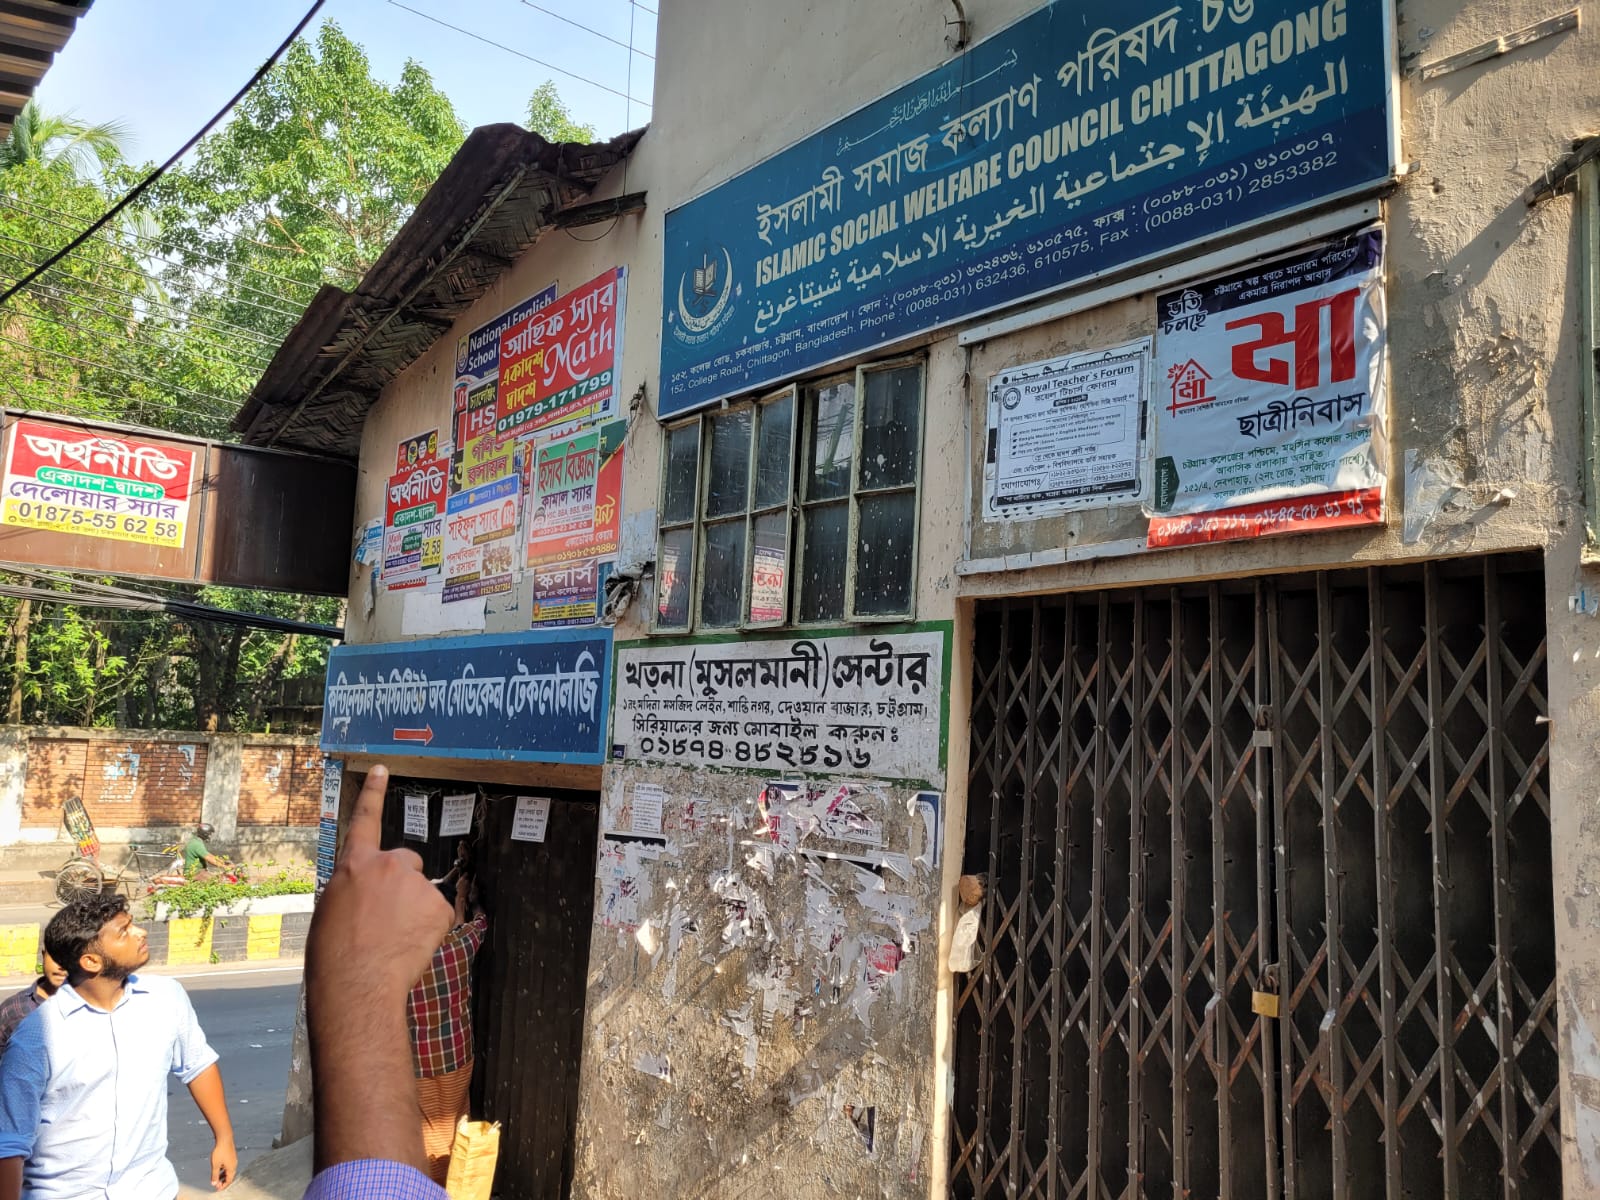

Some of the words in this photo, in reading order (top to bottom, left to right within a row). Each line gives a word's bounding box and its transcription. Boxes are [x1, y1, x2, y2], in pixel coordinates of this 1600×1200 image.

[755, 231, 826, 288] ISLAMIC
[830, 200, 899, 257] SOCIAL
[903, 151, 1002, 226] WELFARE
[1007, 97, 1124, 180] COUNCIL
[1131, 0, 1348, 125] CHITTAGONG
[756, 165, 844, 246] ইসলামী
[852, 133, 931, 197] সমাজ
[939, 72, 1041, 156] কল্যাণ
[1057, 5, 1183, 96] পরিষদ
[954, 182, 1045, 249] الخيرية
[688, 373, 718, 389] College
[720, 364, 745, 378] Road,
[747, 347, 792, 370] Chittagon,
[795, 325, 856, 353] Bangladesh.
[860, 309, 896, 330] Phone
[905, 284, 973, 317] (0088-031)
[976, 263, 1031, 291] 632436,
[1034, 240, 1094, 269] 610575,
[1100, 227, 1129, 247] Fax
[1145, 185, 1243, 233] (0088-031)
[1248, 151, 1338, 195] 2853382
[690, 359, 711, 375] কলেজ
[713, 355, 733, 369] রোড,
[735, 338, 772, 360] চকবাজার,
[775, 327, 804, 346] চট্টগ্রাম,
[858, 299, 881, 316] ফোন
[1093, 207, 1126, 229] ফ্যাক্স
[1143, 162, 1249, 215] (০০৮৮-০৩১)
[1255, 132, 1335, 169] ৬১০৩০৭
[1263, 269, 1284, 285] খরচে
[1286, 259, 1318, 277] মনোরম
[1321, 246, 1360, 266] পরিবেশে
[1239, 286, 1269, 301] একমাত্র
[1271, 277, 1302, 294] নিরাপদ
[1304, 269, 1332, 285] আবাস
[569, 281, 615, 334] স্যার
[1163, 311, 1209, 336] চলছে
[469, 317, 511, 352] National
[543, 318, 613, 387] Math
[1225, 287, 1361, 391] মা
[468, 349, 497, 372] School
[500, 349, 545, 387] একাদশ
[505, 379, 537, 410] দ্বাদশ
[1024, 380, 1051, 396] Royal
[1100, 364, 1134, 380] Forum
[1059, 385, 1083, 399] টিচার্স
[1086, 378, 1117, 394] ফোরাম
[498, 370, 612, 431] 01979-171799
[1236, 392, 1366, 440] ছাত্রীনিবাস
[22, 433, 185, 480] অর্থনীতি
[538, 449, 564, 492] হিসাব
[565, 441, 597, 486] বিজ্ঞান
[1182, 456, 1207, 470] চট্টগ্রাম
[1210, 452, 1244, 468] কলেজের
[1248, 446, 1278, 461] পশ্চিমে,
[1282, 438, 1311, 454] মহসিন
[1313, 433, 1343, 448] কলেজ
[1216, 461, 1252, 476] আবাসিক
[1255, 455, 1288, 470] এলাকায়
[1277, 464, 1297, 479] রোড,
[1300, 457, 1336, 475] মসজিদের
[10, 481, 120, 511] দেলোয়ার
[127, 497, 179, 521] স্যার
[40, 468, 161, 499] একাদশ-দ্বাদশ
[390, 467, 446, 507] অর্থনীতি
[541, 490, 570, 510] কামাল
[572, 484, 594, 505] স্যার
[18, 501, 117, 530] 01875-55
[122, 517, 148, 535] 62
[154, 523, 177, 538] 58
[395, 503, 436, 525] একাদশ-দ্বাদশ
[424, 519, 441, 539] স্যার
[479, 508, 500, 533] স্যার
[536, 559, 595, 592] স্কলার্স
[428, 679, 447, 717] অব
[448, 662, 506, 718] মেডিকেল
[506, 650, 601, 723] টেকনোলজি
[688, 640, 829, 698] (মুসলমানী)
[833, 638, 931, 695] সেন্টার
[638, 698, 661, 712] মদিনা
[663, 697, 693, 713] মসজিদ
[695, 698, 726, 714] লেইন,
[728, 697, 749, 713] শান্তি
[749, 700, 773, 716] নগর,
[778, 701, 825, 716] দেওয়ান
[830, 701, 873, 718] বাজার,
[633, 714, 702, 736] সিরিয়ালের
[708, 720, 739, 738] জন্য
[744, 713, 819, 741] মোবাইল
